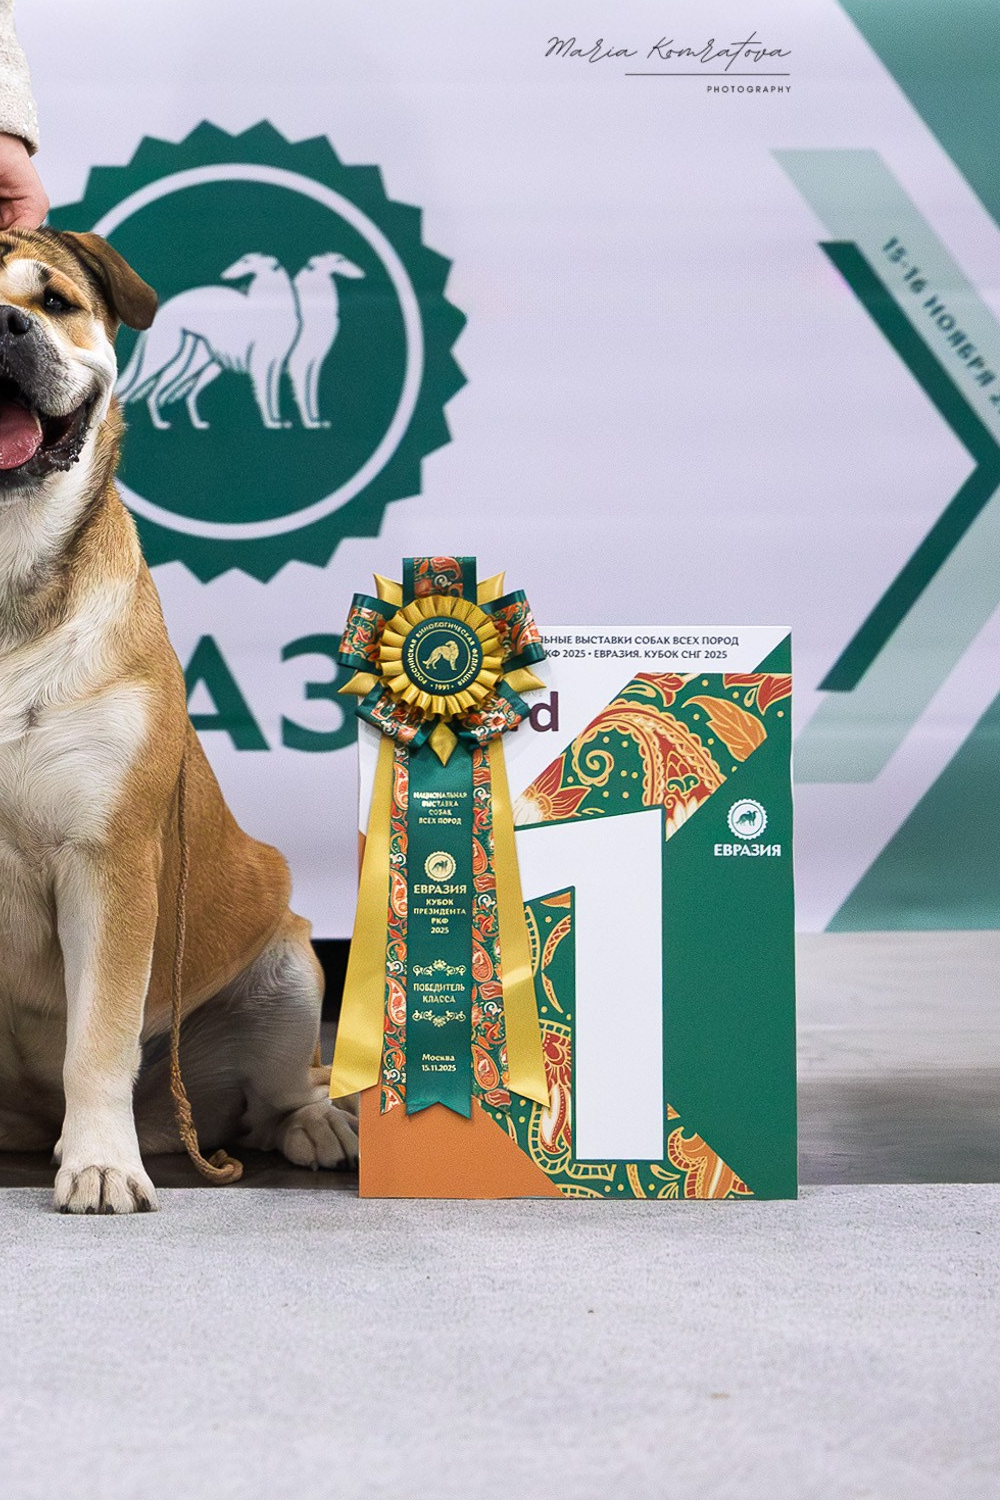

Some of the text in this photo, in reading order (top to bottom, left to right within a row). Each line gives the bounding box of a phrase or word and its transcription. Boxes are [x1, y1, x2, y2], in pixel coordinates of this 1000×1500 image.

[883, 236, 995, 387] 15-16 НОЯБРЯ
[575, 635, 632, 644] ВЫСТАВКИ
[634, 636, 671, 645] СОБАК
[673, 636, 699, 645] ВСЕХ
[702, 636, 740, 646] ПОРОД
[563, 649, 586, 658] 2025
[594, 649, 642, 659] ЕВРАЗИЯ.
[644, 650, 679, 659] КУБОК
[681, 650, 702, 659] СНГ
[704, 650, 728, 659] 2025
[407, 638, 428, 684] РОССИЙСКАЯ
[413, 791, 468, 800] НАЦИОНАЛЬНАЯ
[421, 800, 459, 808] ВЫСТАВКА
[418, 817, 462, 825] ВСЕХ ПОРОД
[714, 844, 782, 856] ЕВРАЗИЯ
[413, 884, 467, 894] ЕВРАЗИЯ
[425, 898, 454, 906] КУБОК
[413, 908, 467, 916] ПРЕЗИДЕНТА
[413, 983, 465, 993] ПОБЕДИТЕЛЬ
[514, 808, 664, 1161] 1
[422, 995, 456, 1003] КЛАССА
[422, 1053, 455, 1062] Москва
[421, 1064, 456, 1072] 15.11.2025
